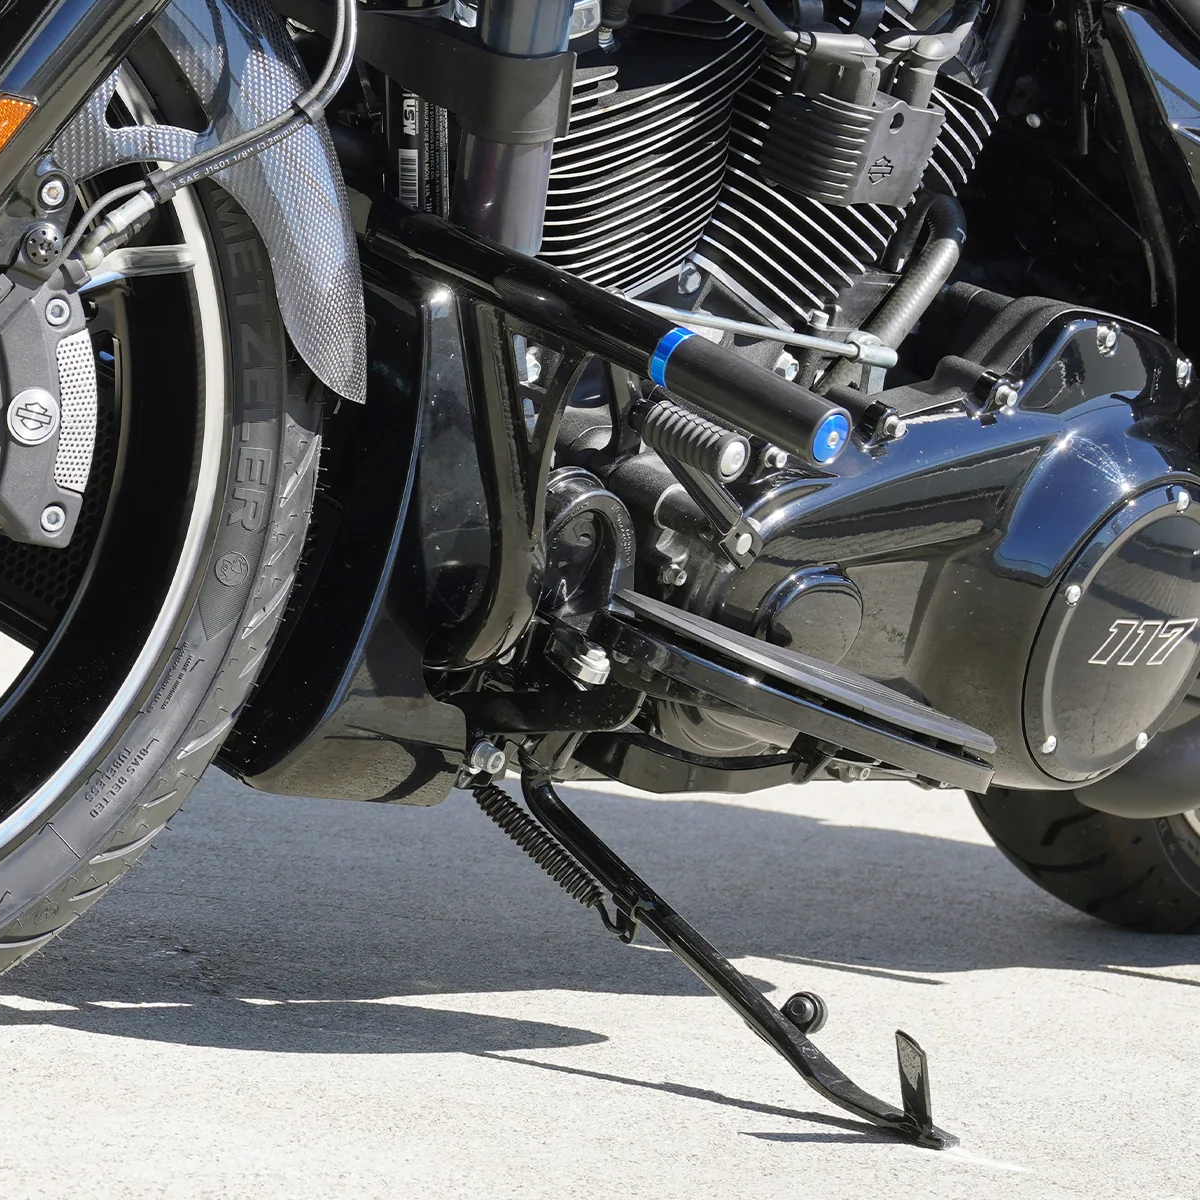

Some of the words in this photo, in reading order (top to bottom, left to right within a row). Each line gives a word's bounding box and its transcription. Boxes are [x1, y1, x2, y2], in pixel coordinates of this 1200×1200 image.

[180, 172, 200, 186] SAE
[204, 159, 230, 175] J1401
[1088, 618, 1199, 666] 117
[128, 747, 149, 775] BIAS
[89, 777, 128, 818] BELTED
